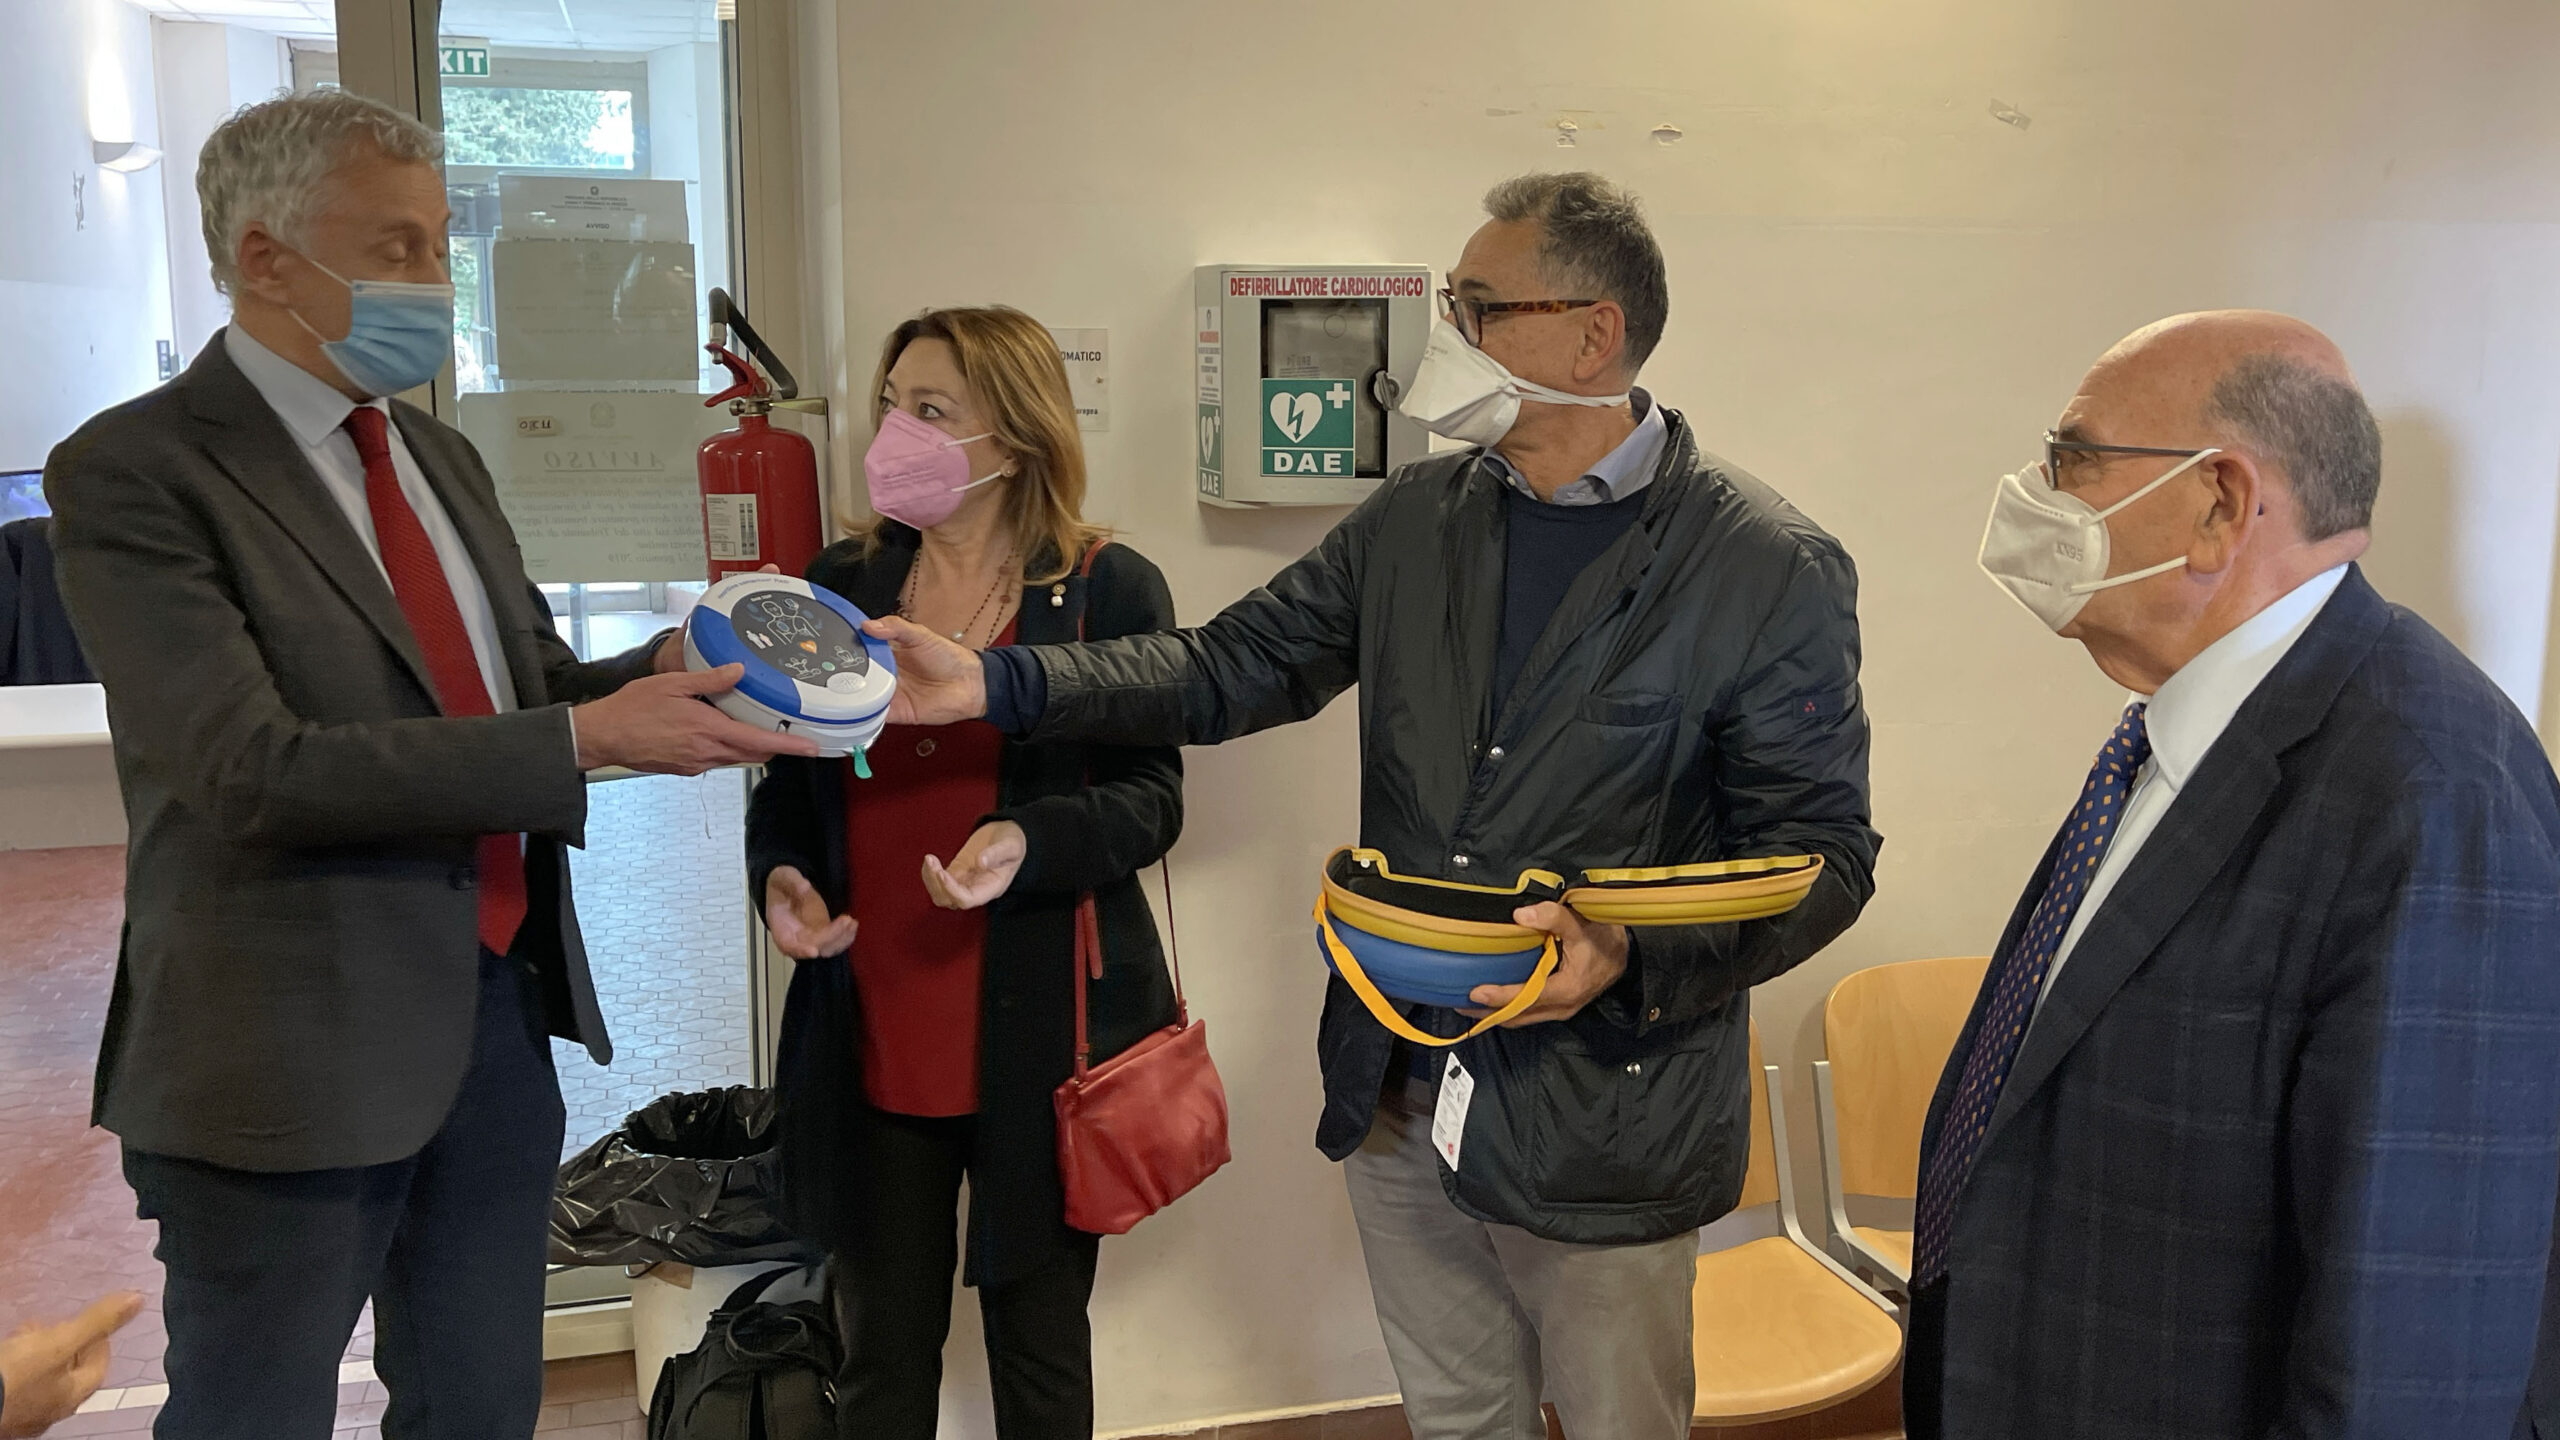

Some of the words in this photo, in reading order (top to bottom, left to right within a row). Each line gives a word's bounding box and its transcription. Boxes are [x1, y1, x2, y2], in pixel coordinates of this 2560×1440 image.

[439, 49, 484, 73] XIT
[1230, 276, 1328, 296] DEFIBRILLATORE
[1330, 276, 1424, 297] CARDIOLOGICO
[1060, 351, 1103, 362] OMATICO
[1274, 452, 1342, 474] DAE
[1202, 472, 1219, 495] DAE
